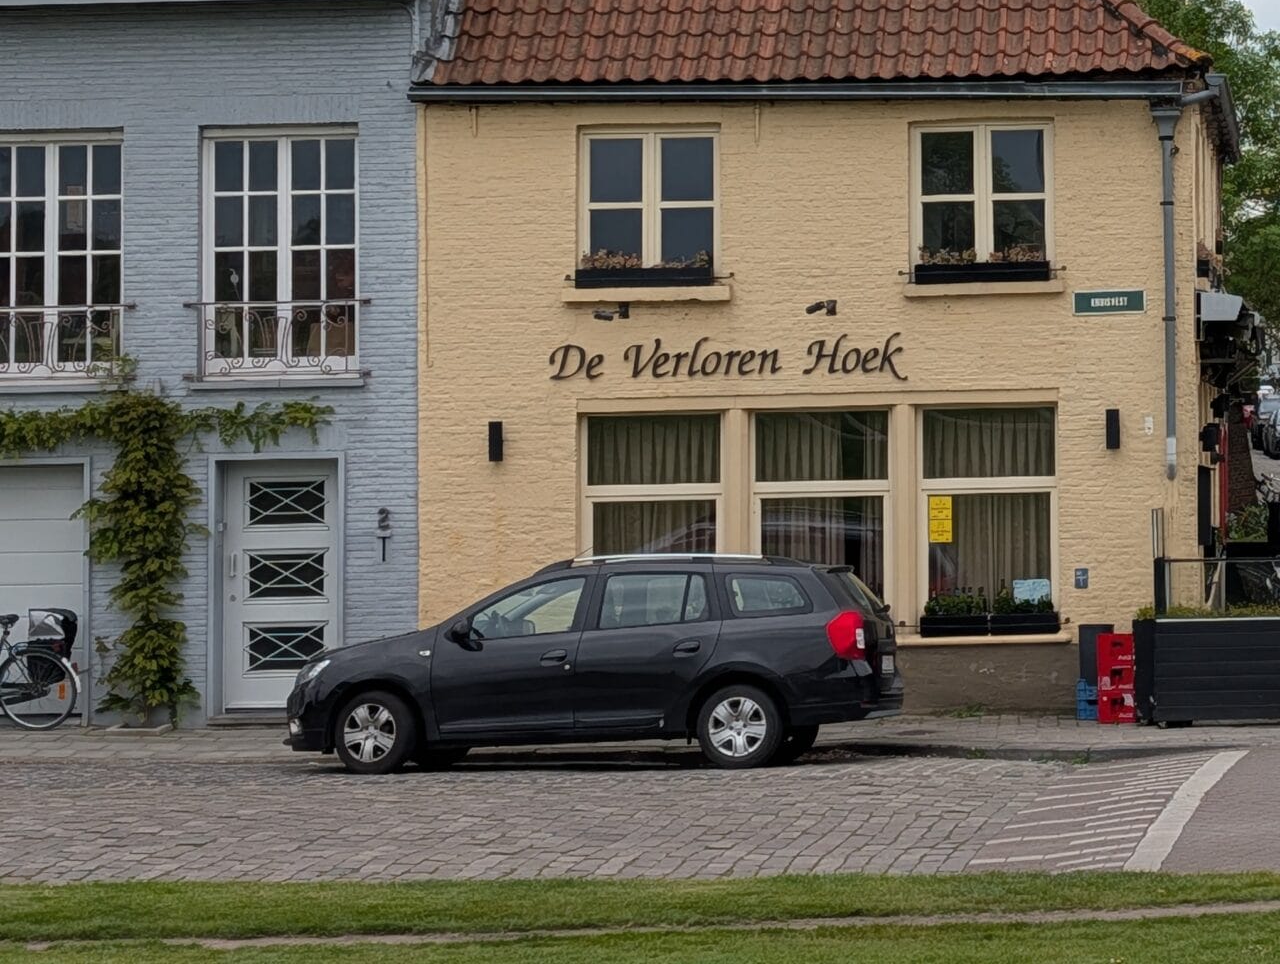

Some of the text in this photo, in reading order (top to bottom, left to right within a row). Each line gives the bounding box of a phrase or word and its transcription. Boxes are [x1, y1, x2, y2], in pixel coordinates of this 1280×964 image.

[549, 332, 908, 381] De Verloren Hoek
[378, 507, 391, 531] 2
